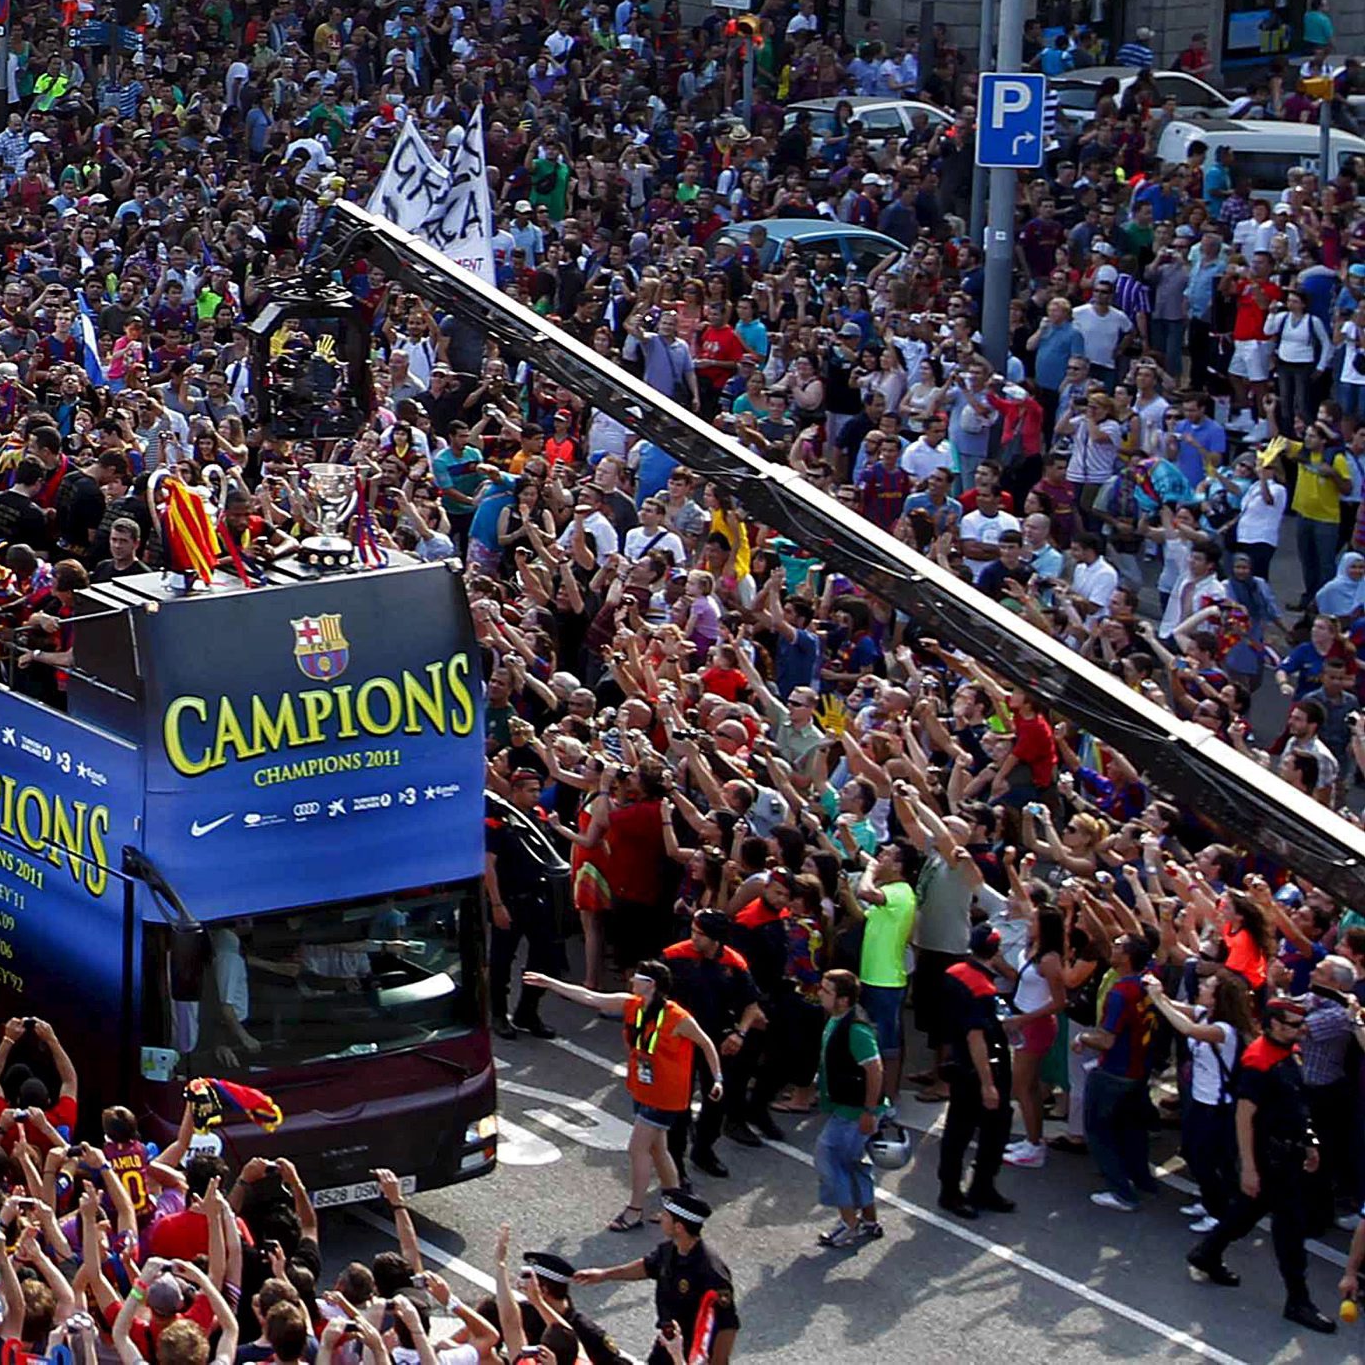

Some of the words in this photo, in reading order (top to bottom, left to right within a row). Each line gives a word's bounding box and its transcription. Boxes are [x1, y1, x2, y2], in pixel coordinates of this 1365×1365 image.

[992, 80, 1032, 129] P
[162, 652, 475, 775] CAMPIONS
[254, 752, 362, 787] CHAMPIONS
[365, 749, 401, 767] 2011
[16, 858, 44, 890] 2011
